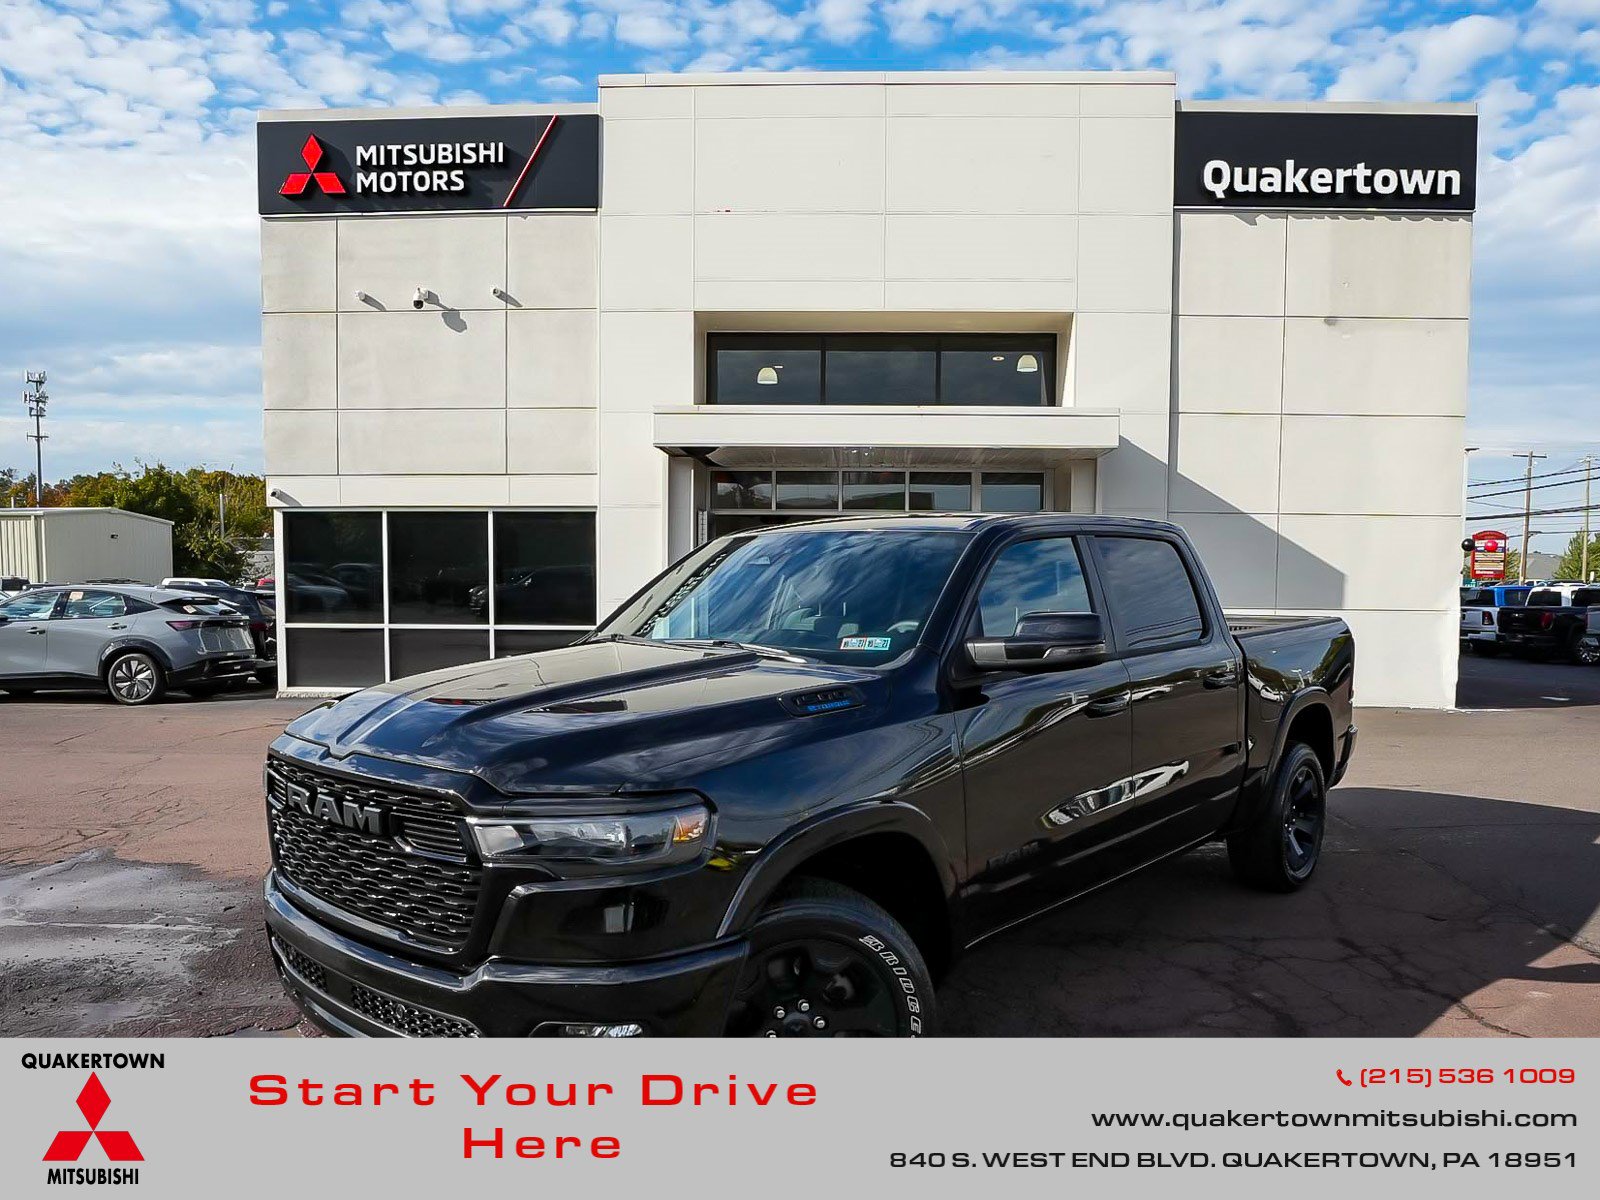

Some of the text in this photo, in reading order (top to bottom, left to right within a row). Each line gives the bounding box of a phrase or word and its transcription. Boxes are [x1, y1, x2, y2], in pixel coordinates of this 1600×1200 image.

[356, 142, 505, 167] MITSUBISHI
[356, 169, 466, 193] MOTORS
[1203, 159, 1461, 199] Quakertown
[286, 780, 383, 836] RAM
[858, 934, 922, 1038] BRIDGE
